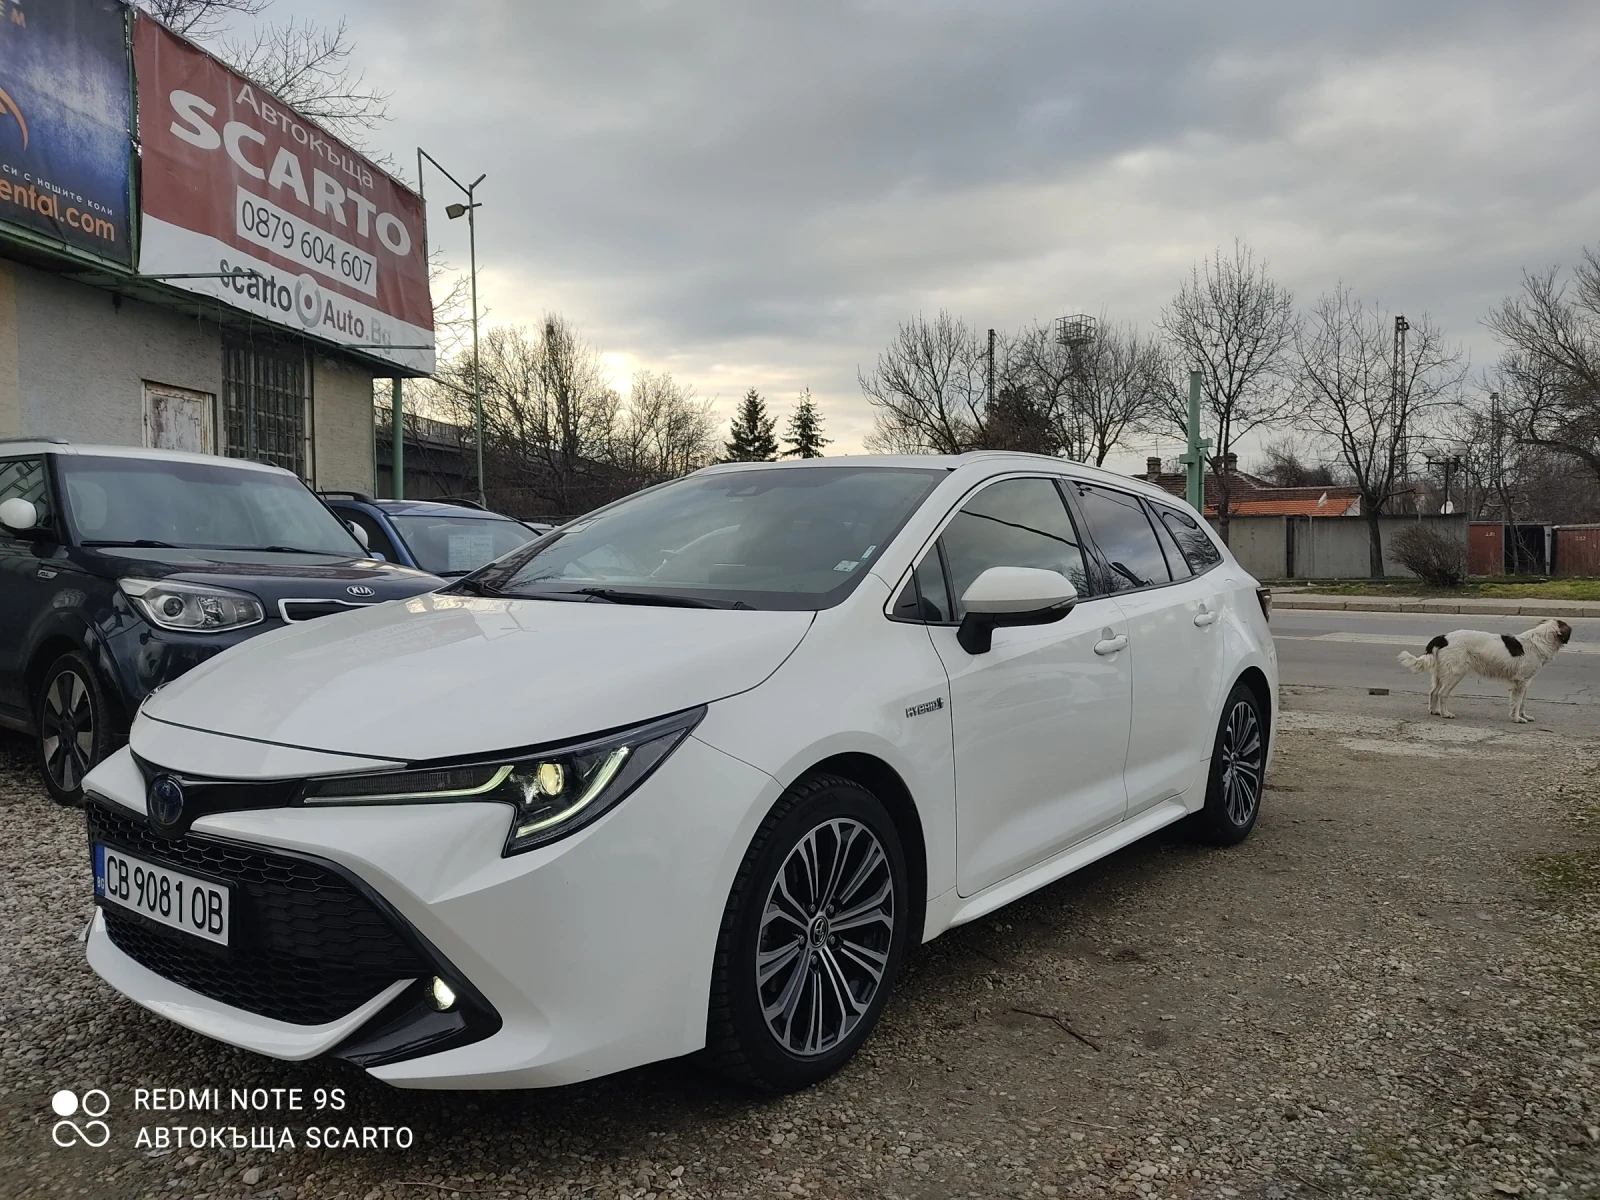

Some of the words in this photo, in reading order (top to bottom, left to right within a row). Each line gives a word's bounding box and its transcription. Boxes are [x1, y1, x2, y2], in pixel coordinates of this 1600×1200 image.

[169, 89, 411, 256] SCARTO
[236, 84, 374, 190] Автокъща
[37, 177, 83, 203] нашите
[87, 199, 113, 216] коли
[241, 200, 295, 249] 0879
[300, 231, 336, 270] 604
[340, 251, 372, 285] 607
[351, 586, 372, 594] KIA
[107, 855, 130, 901] CB
[133, 866, 183, 923] 9081
[191, 886, 224, 935] OB
